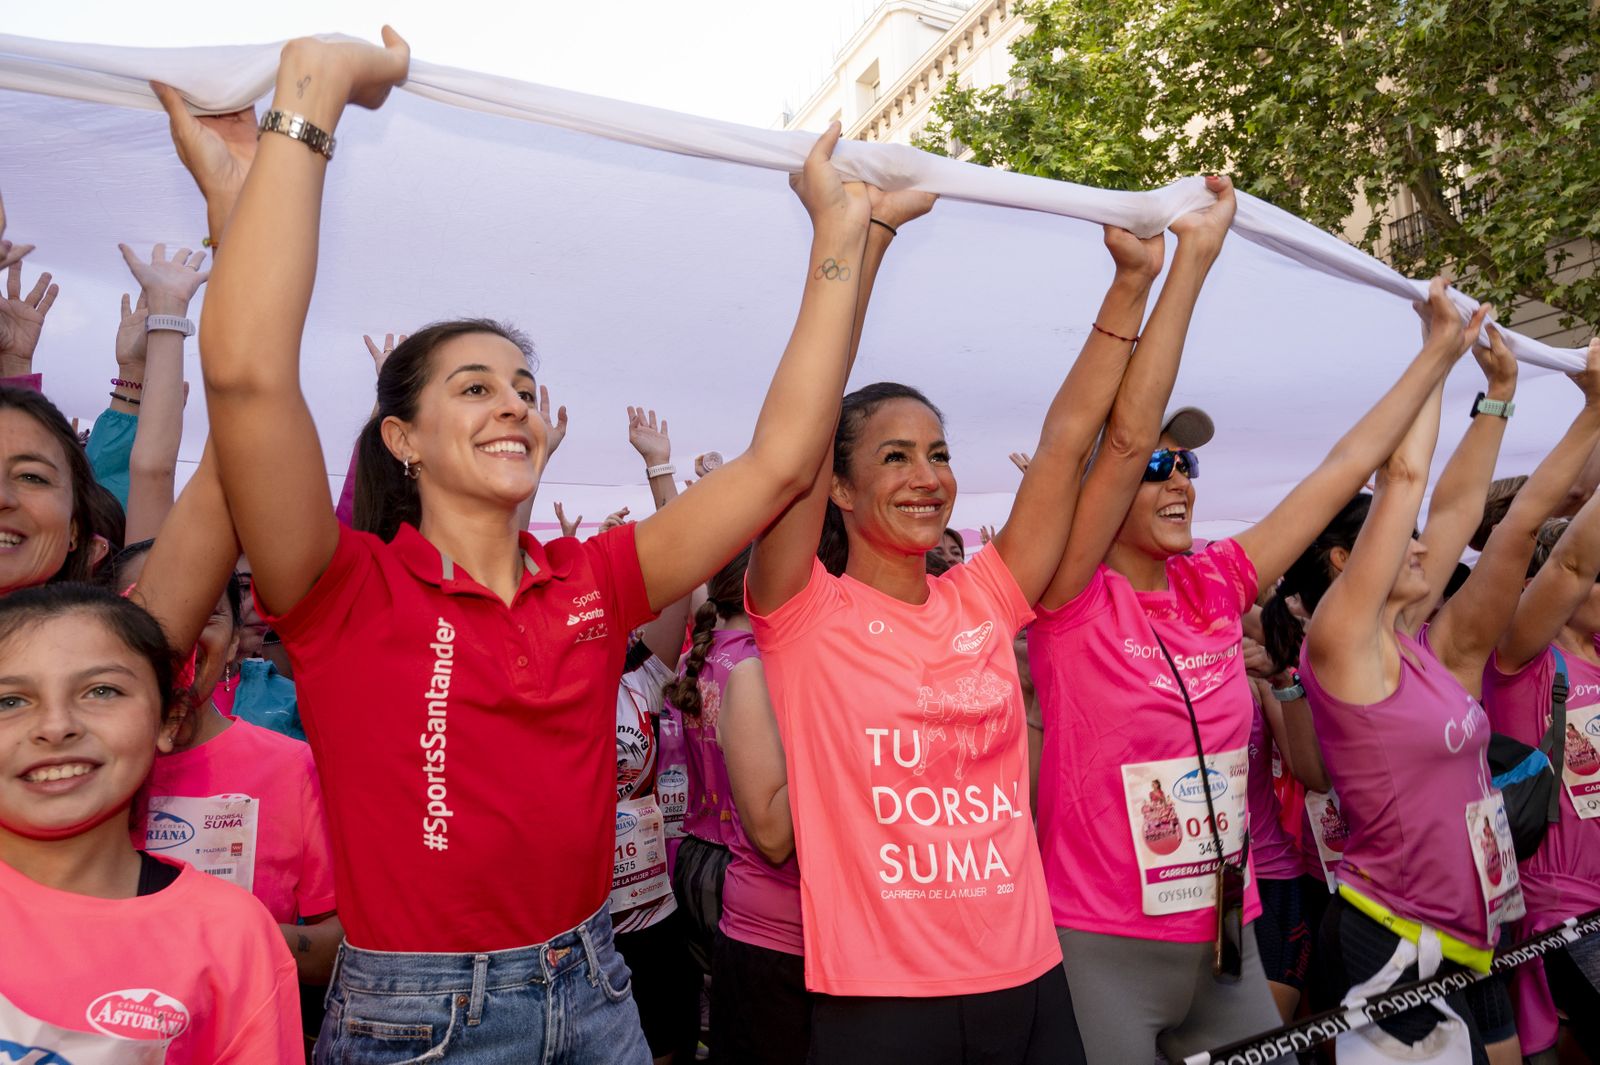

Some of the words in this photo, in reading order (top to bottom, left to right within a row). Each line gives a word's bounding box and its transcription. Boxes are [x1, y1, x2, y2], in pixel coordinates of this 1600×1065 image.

[1124, 638, 1166, 660] Sport
[420, 616, 456, 852] #SportsSantander
[617, 724, 650, 751] nning
[865, 728, 921, 768] TU
[662, 792, 686, 804] 016
[872, 781, 1023, 826] DORSAL
[203, 819, 243, 830] SUMA
[146, 830, 188, 841] RIANA
[615, 842, 637, 860] 16
[879, 838, 1011, 884] SUMA
[622, 877, 630, 885] LA
[1158, 866, 1199, 880] CARRERA
[881, 889, 926, 900] CARRERA
[928, 889, 942, 899] DE
[944, 888, 956, 899] LA
[958, 887, 987, 898] MUJER
[996, 883, 1015, 895] 2023
[1158, 886, 1203, 903] OYSHO
